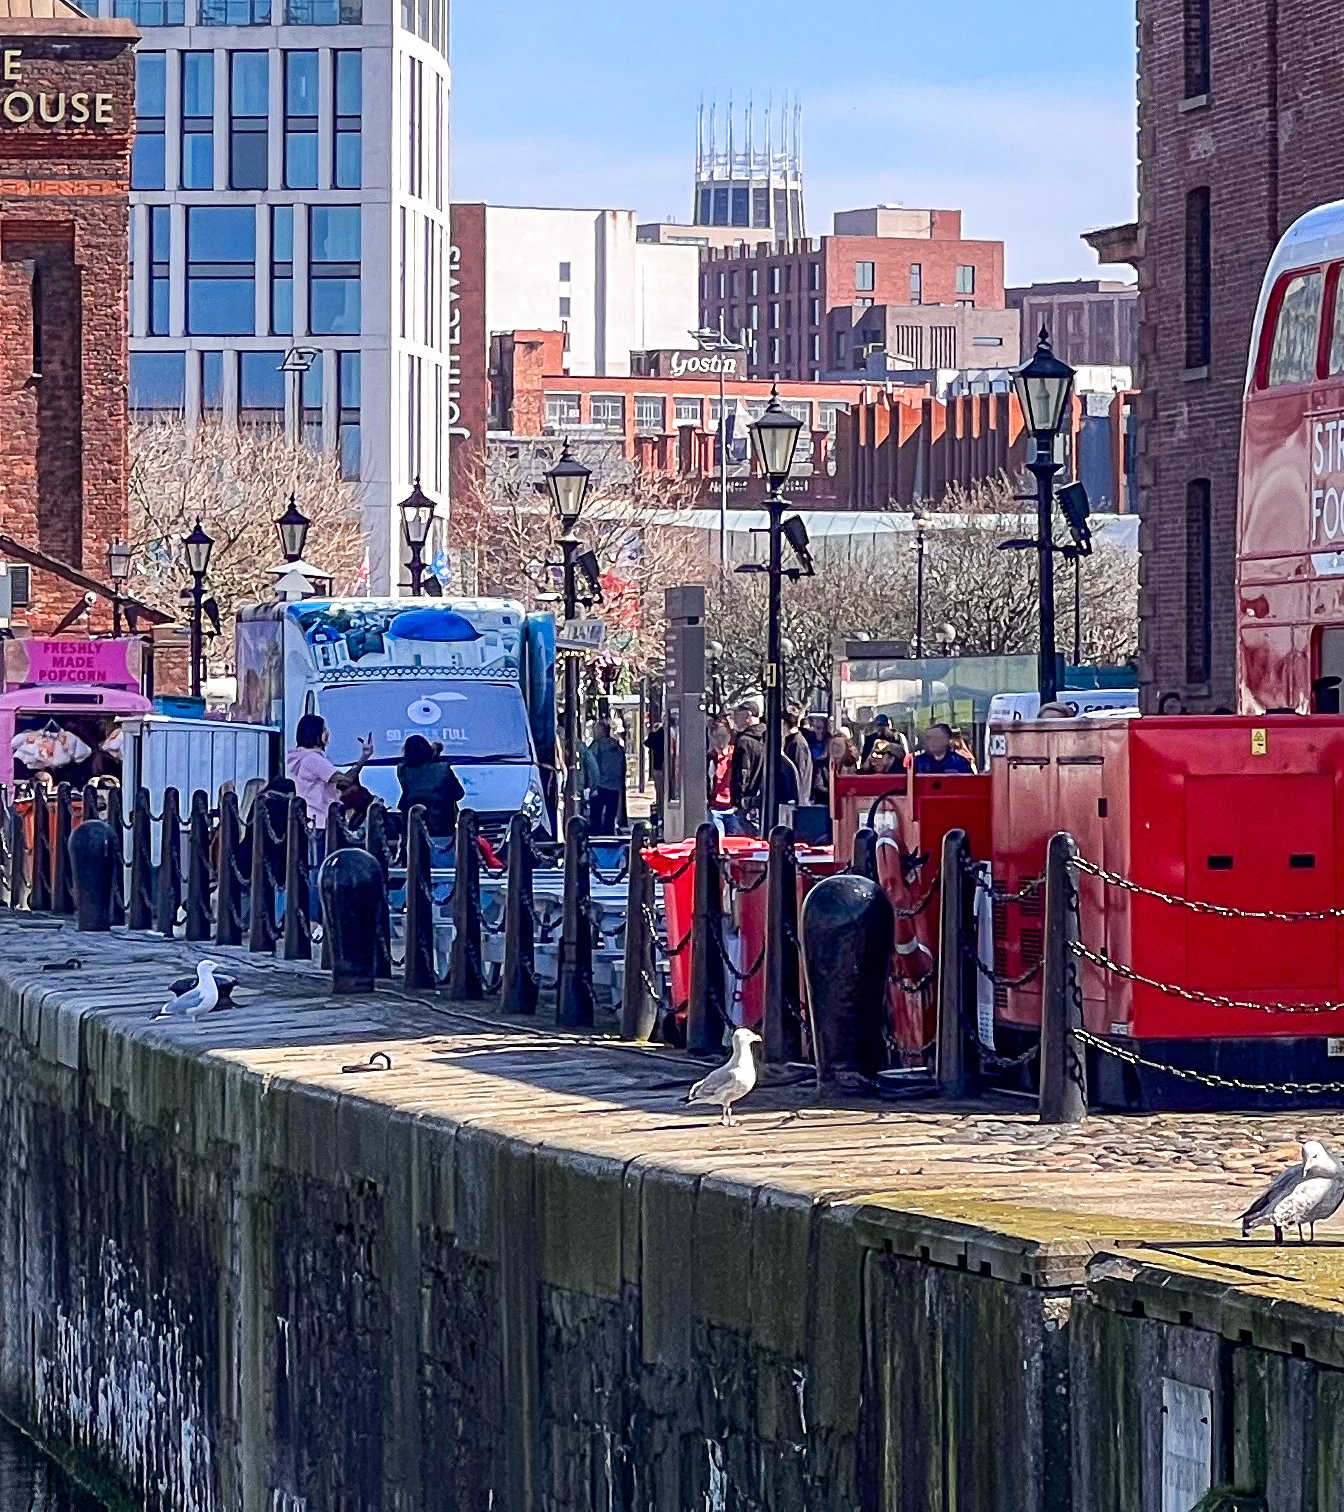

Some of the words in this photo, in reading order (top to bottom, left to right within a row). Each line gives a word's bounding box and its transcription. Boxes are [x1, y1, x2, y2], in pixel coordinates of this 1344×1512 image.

[670, 351, 737, 377] Gostin
[43, 642, 103, 654] FRESHLY
[52, 657, 94, 668] MADE
[38, 669, 106, 682] POPCORN
